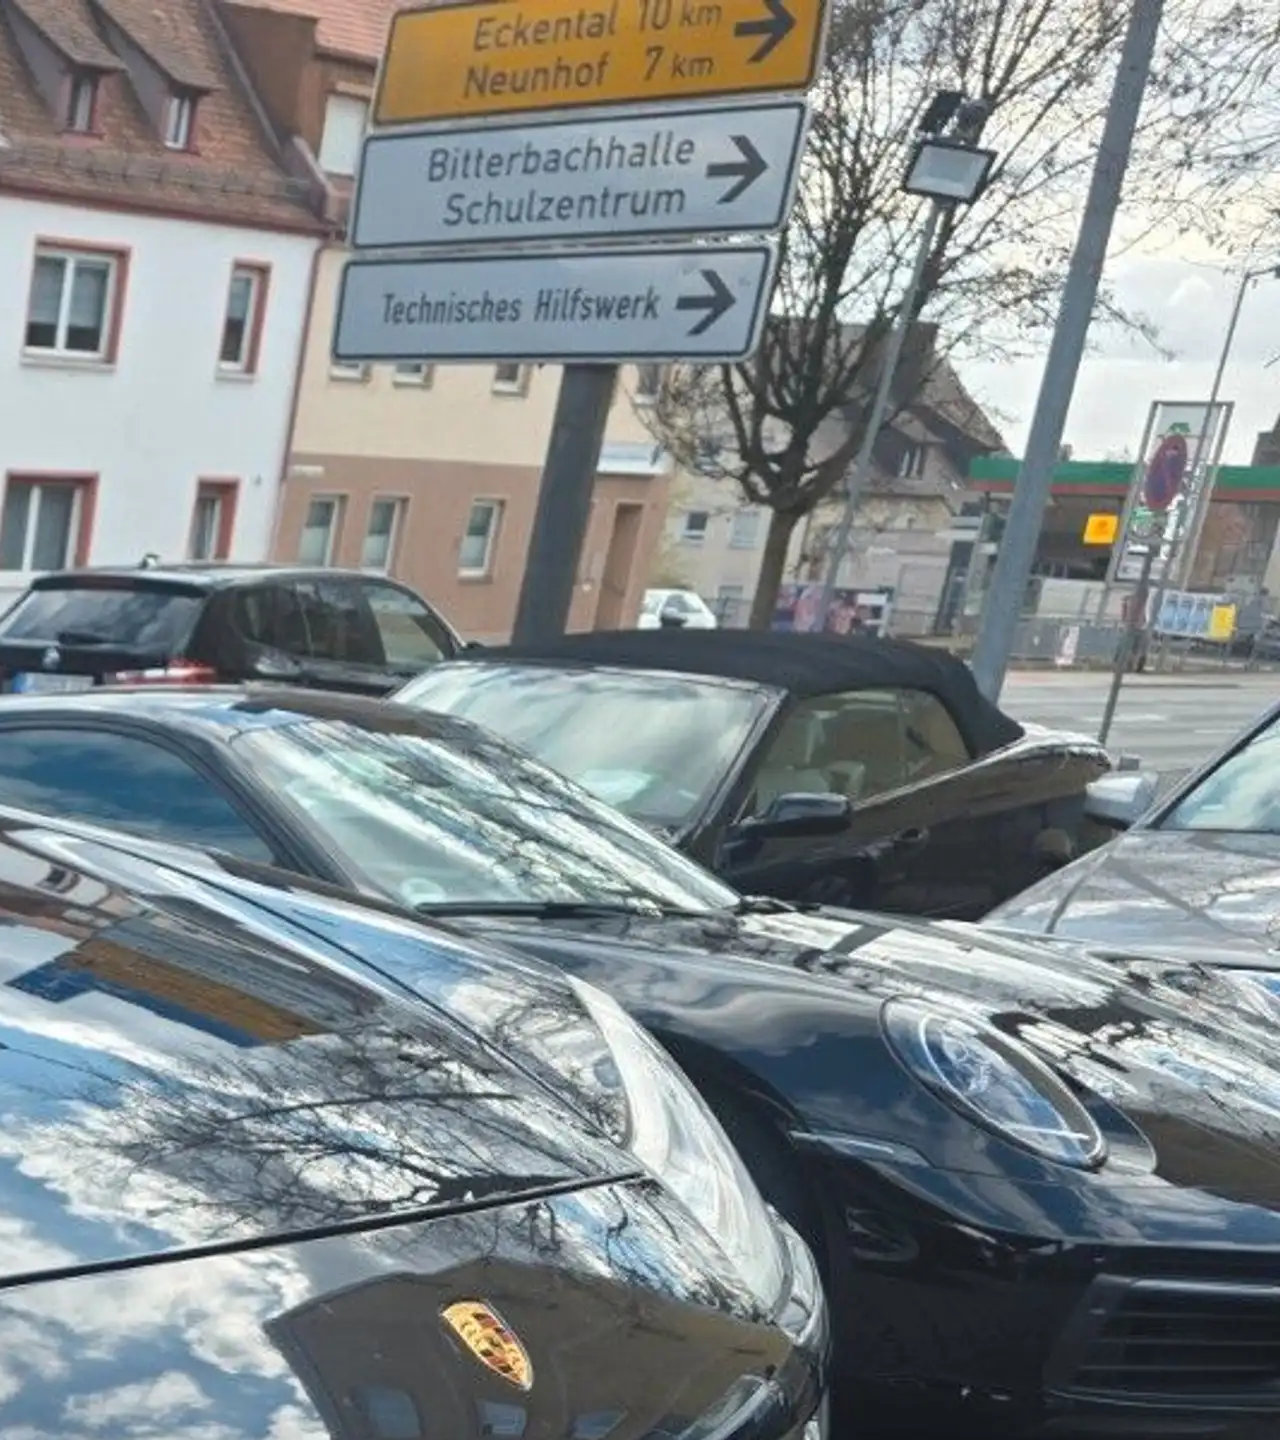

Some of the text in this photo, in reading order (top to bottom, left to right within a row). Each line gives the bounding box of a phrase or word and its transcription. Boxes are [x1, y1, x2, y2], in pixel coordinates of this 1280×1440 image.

[473, 0, 722, 51] Eckental 10 km
[463, 46, 715, 98] Neunhof 7 km
[428, 131, 695, 182] Bitterbachhalle
[443, 187, 686, 226] Schulzentrum
[380, 286, 662, 326] Technisches Hilfswerk
